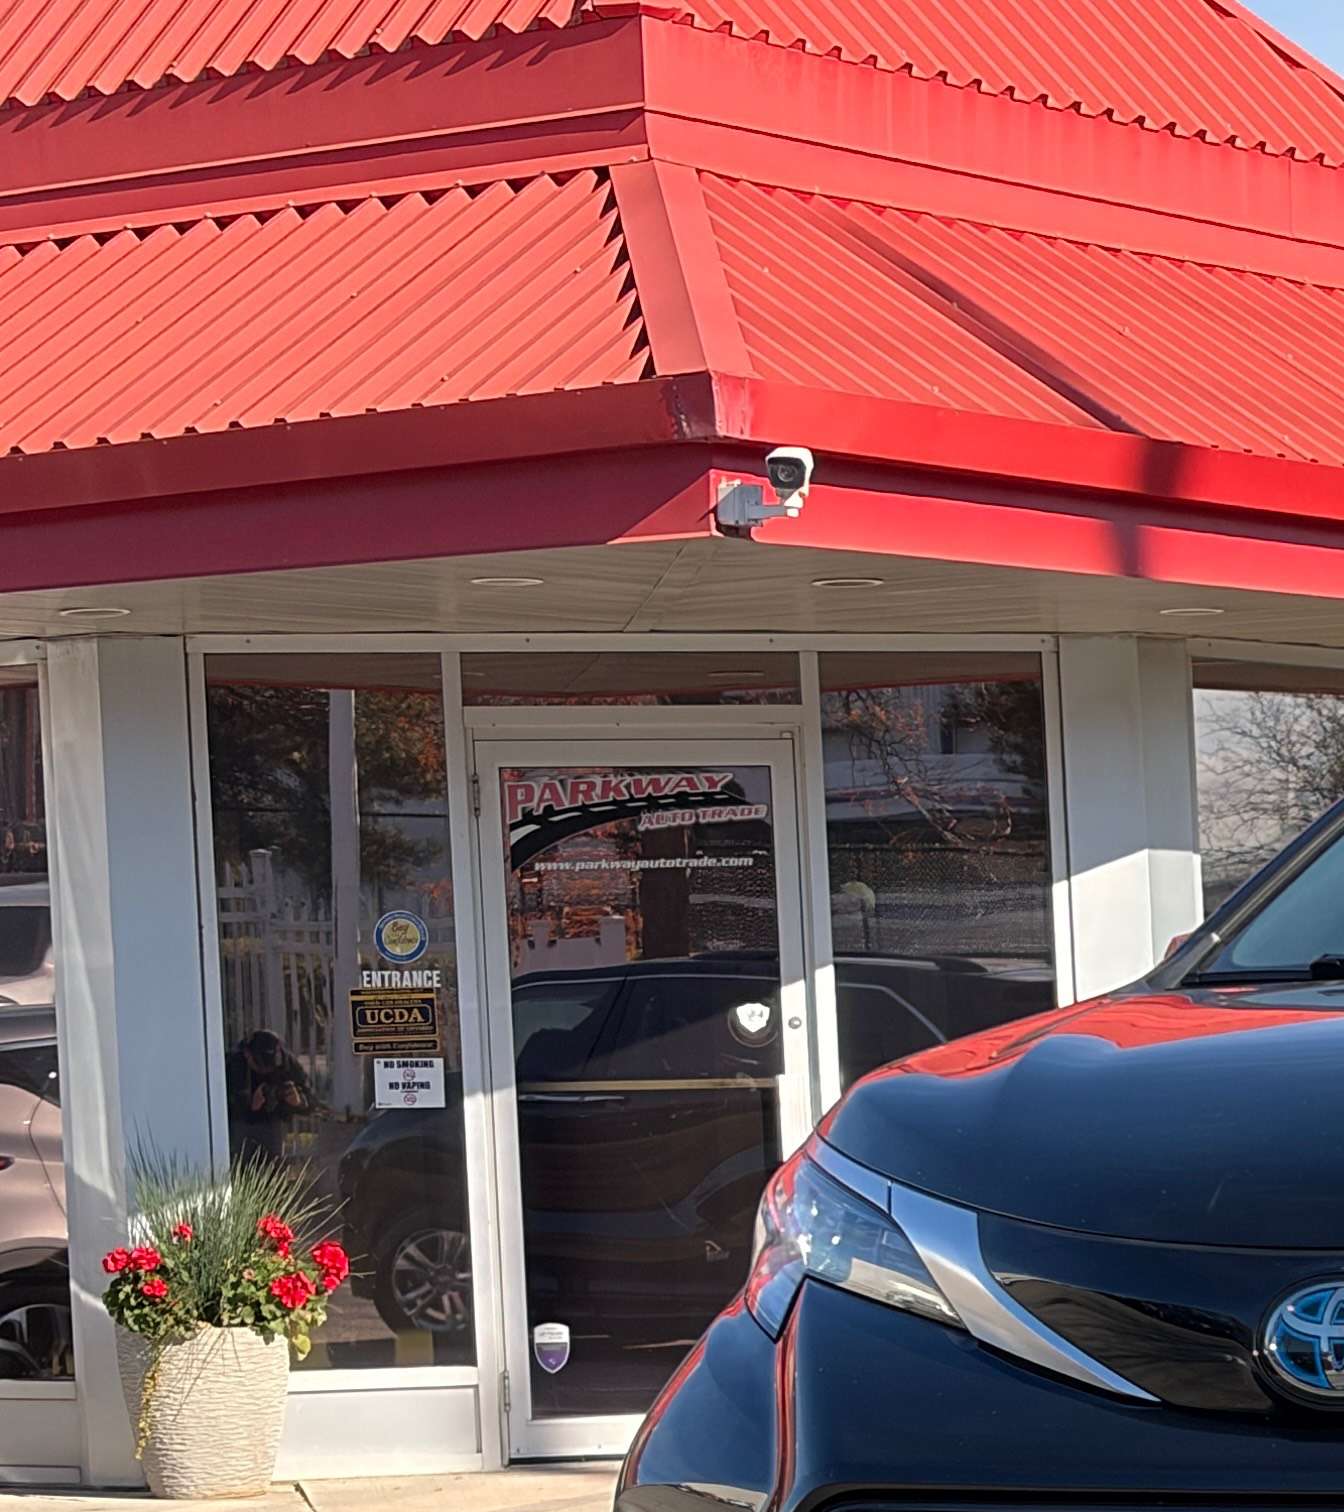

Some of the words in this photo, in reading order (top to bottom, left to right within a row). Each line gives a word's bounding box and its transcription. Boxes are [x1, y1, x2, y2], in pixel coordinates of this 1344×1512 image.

[506, 772, 733, 824] PARKWAY
[638, 806, 696, 831] AUTO
[698, 804, 768, 827] TRADE
[534, 856, 754, 872] www.parkwayautotrade.com
[362, 970, 442, 988] ENTRANCE
[365, 1008, 424, 1024] UCDA
